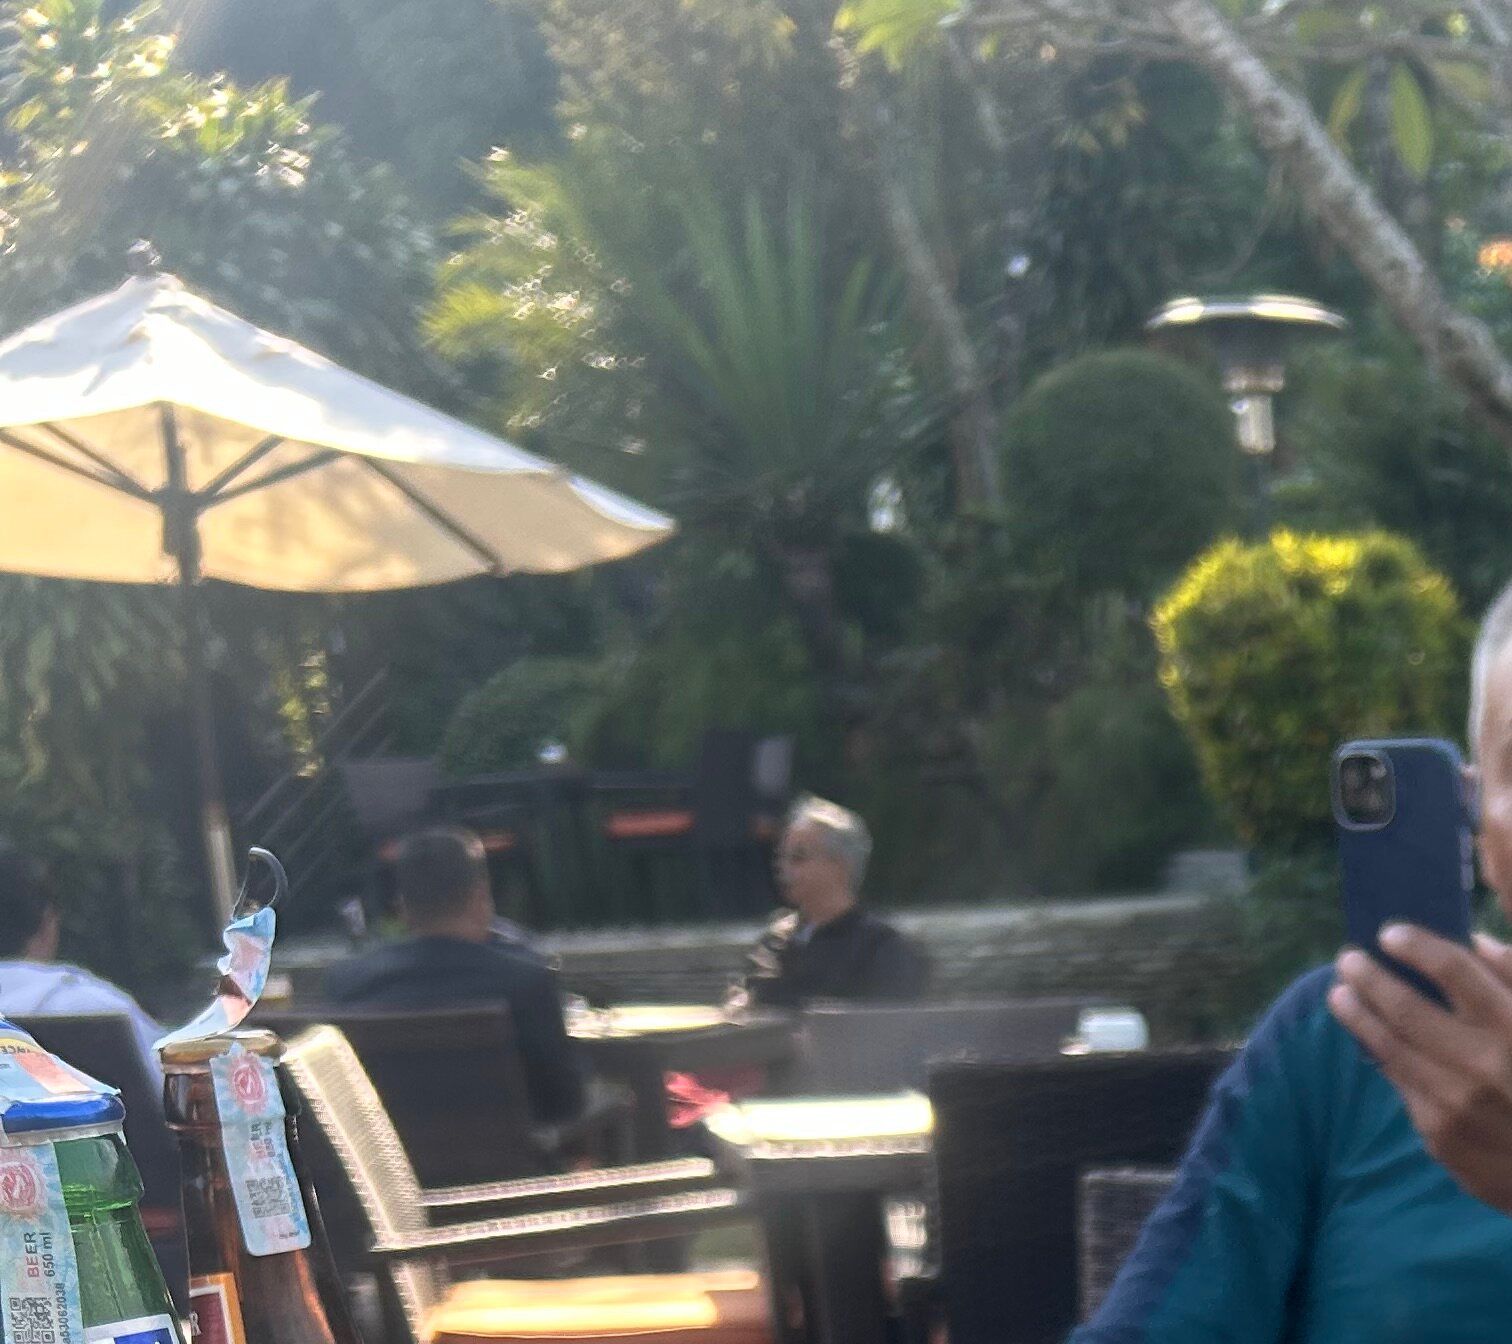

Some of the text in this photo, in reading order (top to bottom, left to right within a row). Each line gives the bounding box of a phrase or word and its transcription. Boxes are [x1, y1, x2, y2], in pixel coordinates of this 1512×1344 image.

[23, 1231, 40, 1278] BEER
[40, 1232, 56, 1278] 650 ml
